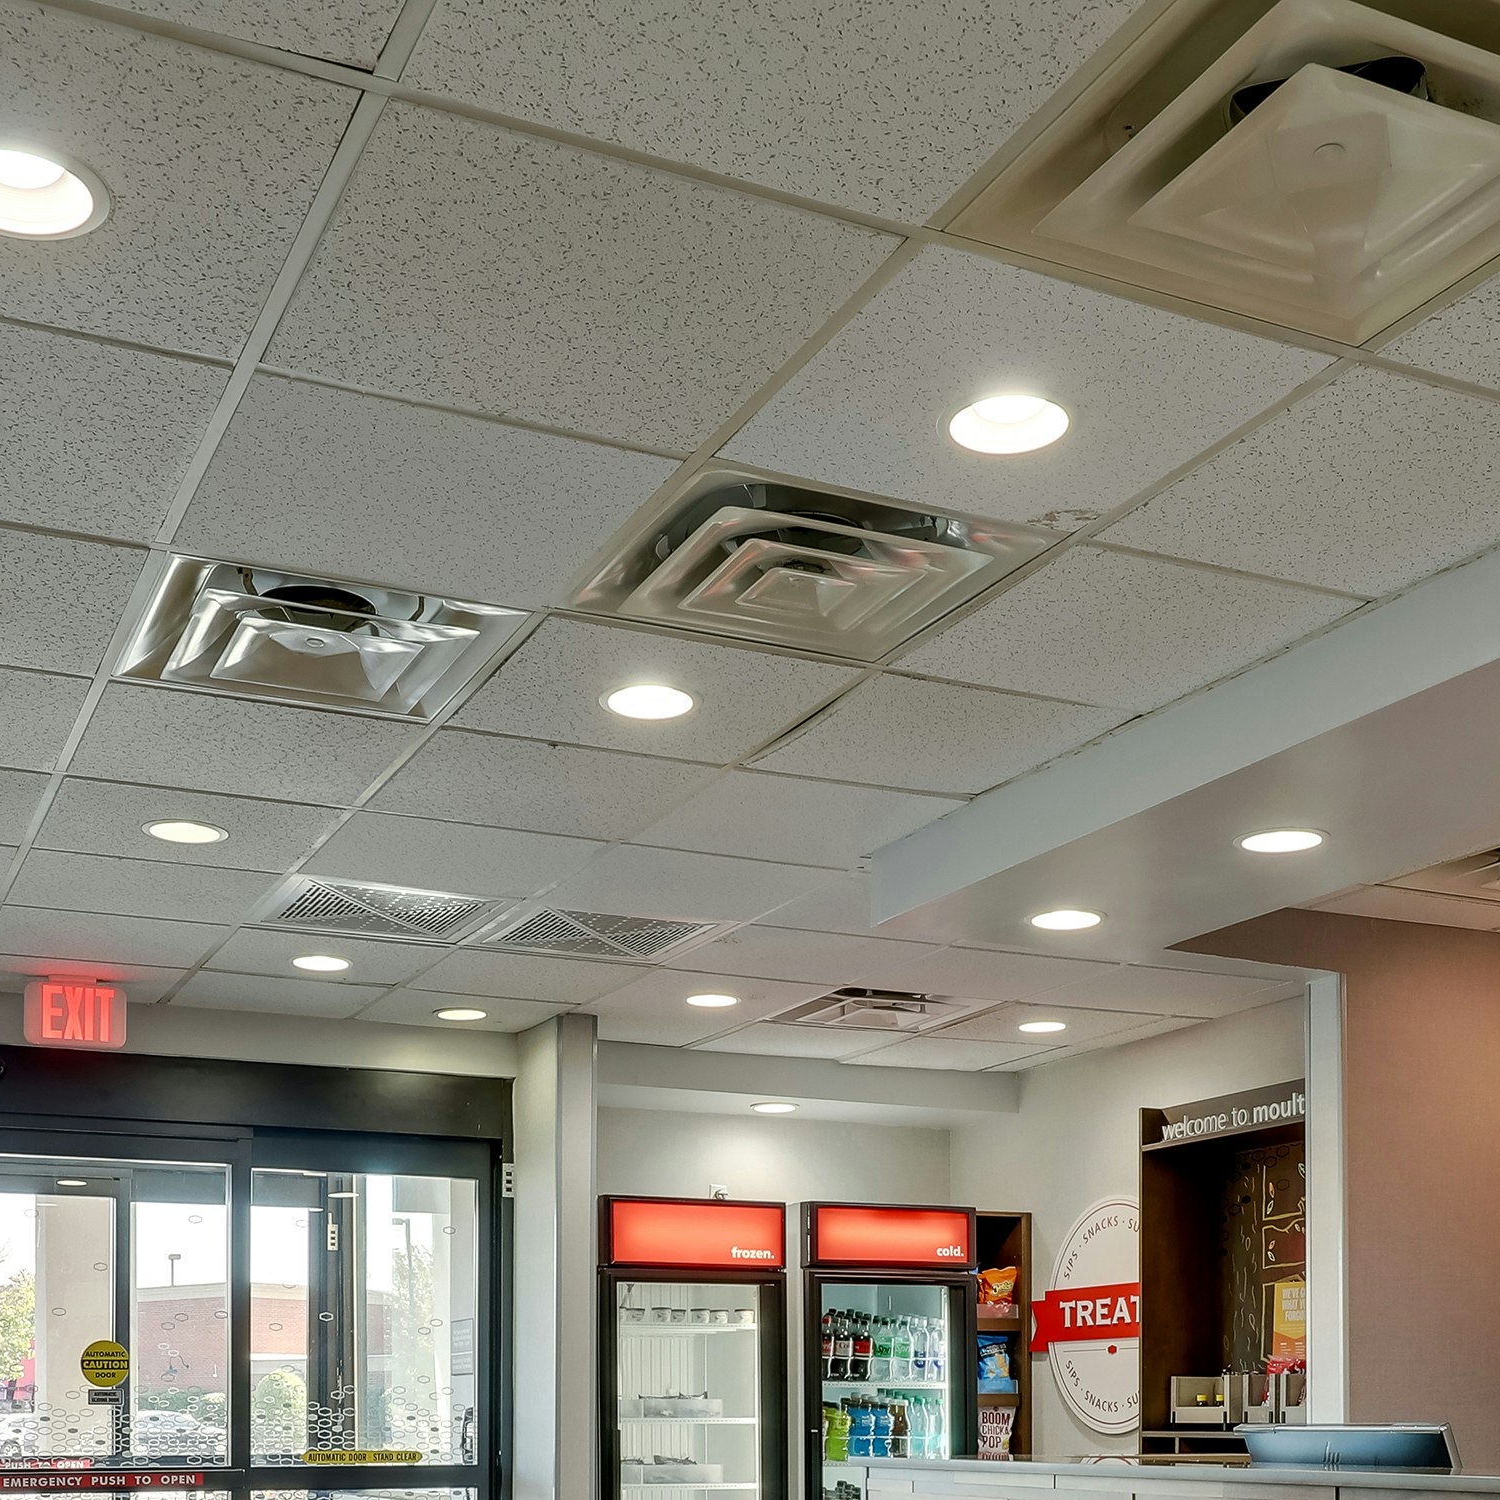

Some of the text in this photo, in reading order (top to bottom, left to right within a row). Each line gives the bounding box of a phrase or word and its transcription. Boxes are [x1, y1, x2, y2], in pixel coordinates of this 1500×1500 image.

[42, 984, 116, 1042] EXIT
[1161, 1113, 1227, 1141] welcome
[1231, 1107, 1248, 1127] to
[731, 1246, 775, 1260] frozen.
[936, 1246, 965, 1257] cold.
[1062, 1250, 1079, 1281] SIPS
[1082, 1215, 1119, 1245] SNACKS
[83, 1360, 128, 1369] CAUTION
[1065, 1360, 1080, 1387] SIPS
[1084, 1390, 1119, 1413] SNACKS
[982, 1411, 1011, 1426] BOOM
[982, 1425, 1011, 1436] CHICKA
[982, 1435, 1003, 1449] POP
[308, 1453, 346, 1461] AUTOMATIC
[348, 1453, 367, 1461] DOOR
[373, 1453, 394, 1461] STAND
[2, 1476, 83, 1488] EMERGENCY
[91, 1476, 126, 1486] PUSH
[134, 1475, 152, 1485] TO
[160, 1474, 196, 1485] OPEN
